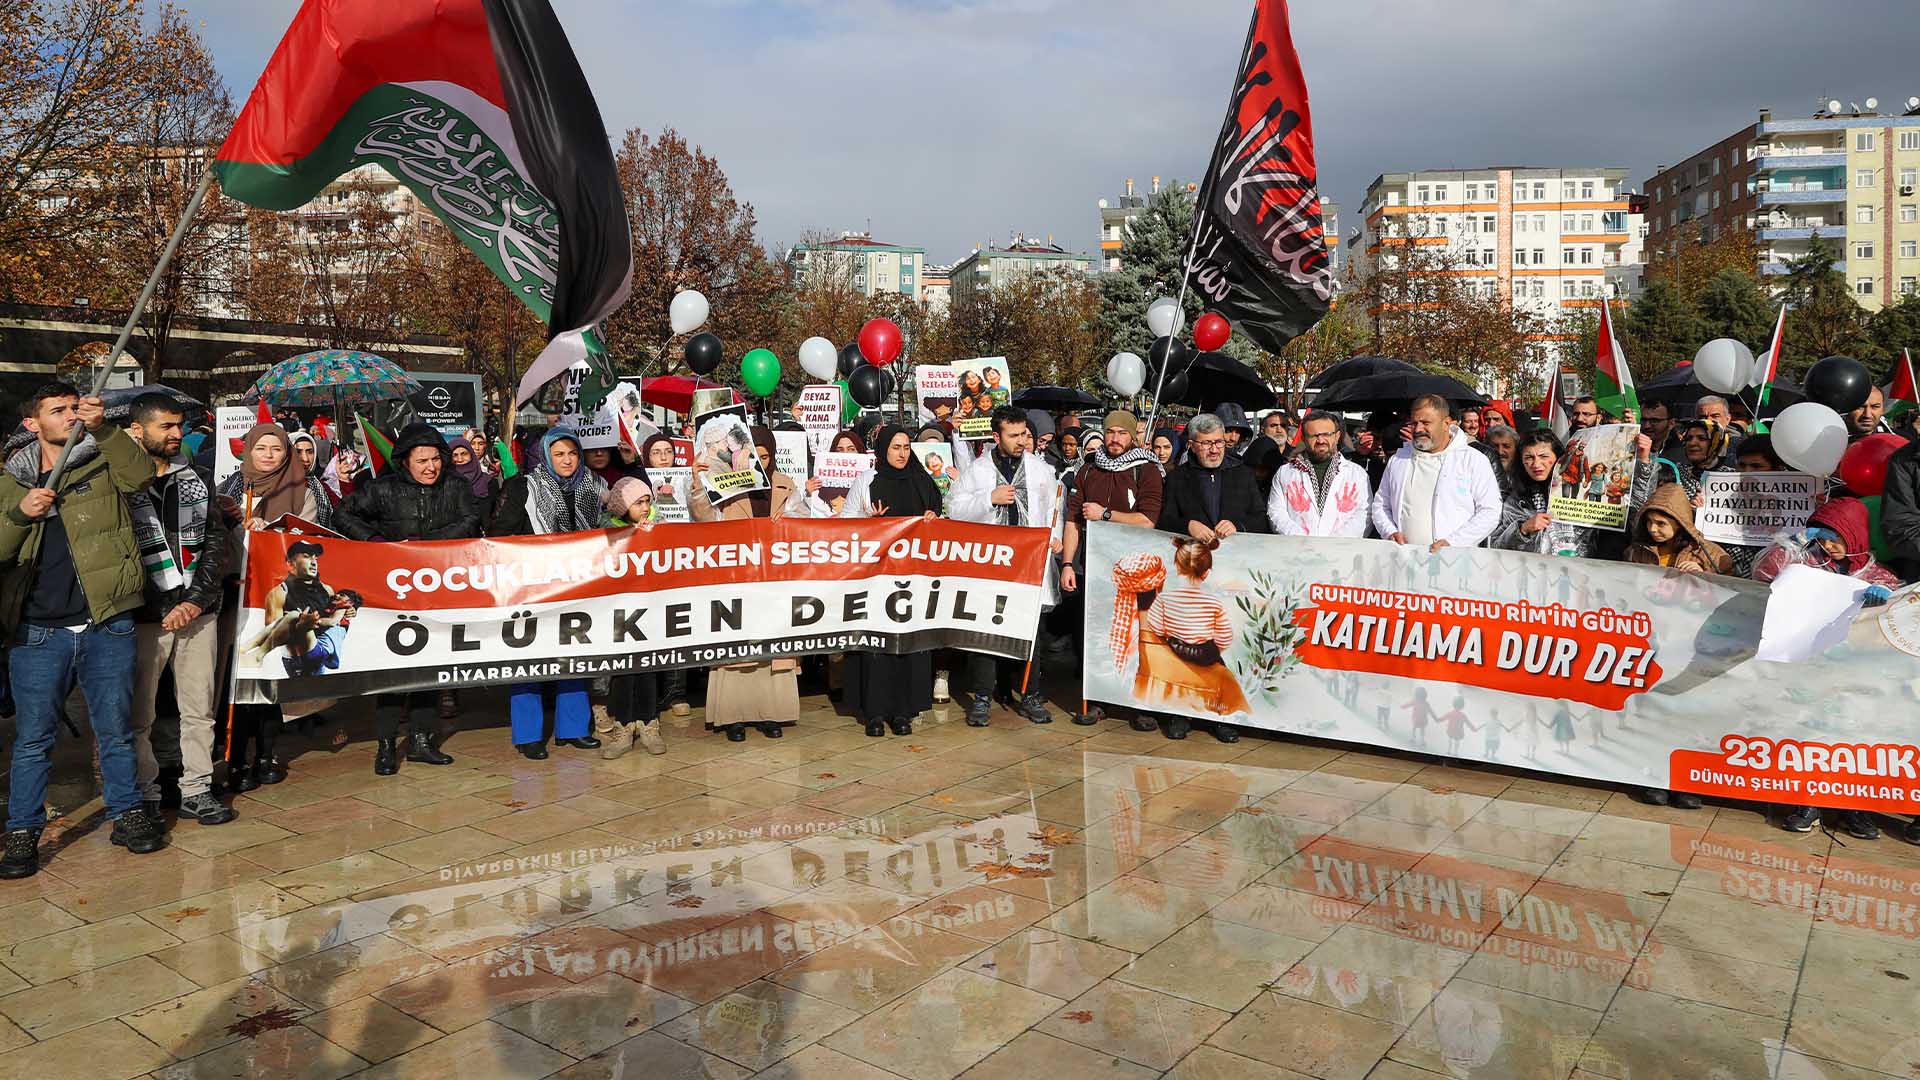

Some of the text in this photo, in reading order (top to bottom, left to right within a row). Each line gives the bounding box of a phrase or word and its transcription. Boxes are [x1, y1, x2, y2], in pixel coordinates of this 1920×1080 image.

[569, 368, 592, 384] WH
[804, 392, 831, 401] BEYAZ
[563, 397, 607, 415] STP
[439, 411, 463, 419] Qashqai
[578, 417, 594, 426] THE
[805, 414, 829, 422] KANA
[574, 426, 612, 437] NOCIDE?
[826, 458, 857, 467] BABY
[1710, 482, 1808, 494] ÇOCUKLARIN
[1710, 497, 1809, 511] HAYALLERİNİ
[1704, 512, 1807, 527] ÖLDÜRMEYİN
[386, 533, 1014, 600] ÇOCUKLAR UYURKEN SESSİZ OLUNUR
[385, 580, 1009, 656] ÖLÜRKEN DEĞİL!
[1311, 585, 1649, 637] RUHUMUZUN RUHU RİM'İN GÜNÜ
[1310, 610, 1656, 688] KATLİAMA DUR DE!
[438, 635, 886, 683] DİYARBAKIR İSLAMİ SİVİL TOPLUM KURULUŞLARI
[1725, 738, 1917, 779] 23 ARALIK
[1690, 768, 1746, 788] DÜNYA
[1751, 776, 1801, 792] ŞEHİT
[1806, 780, 1905, 801] ÇOCUKLAR
